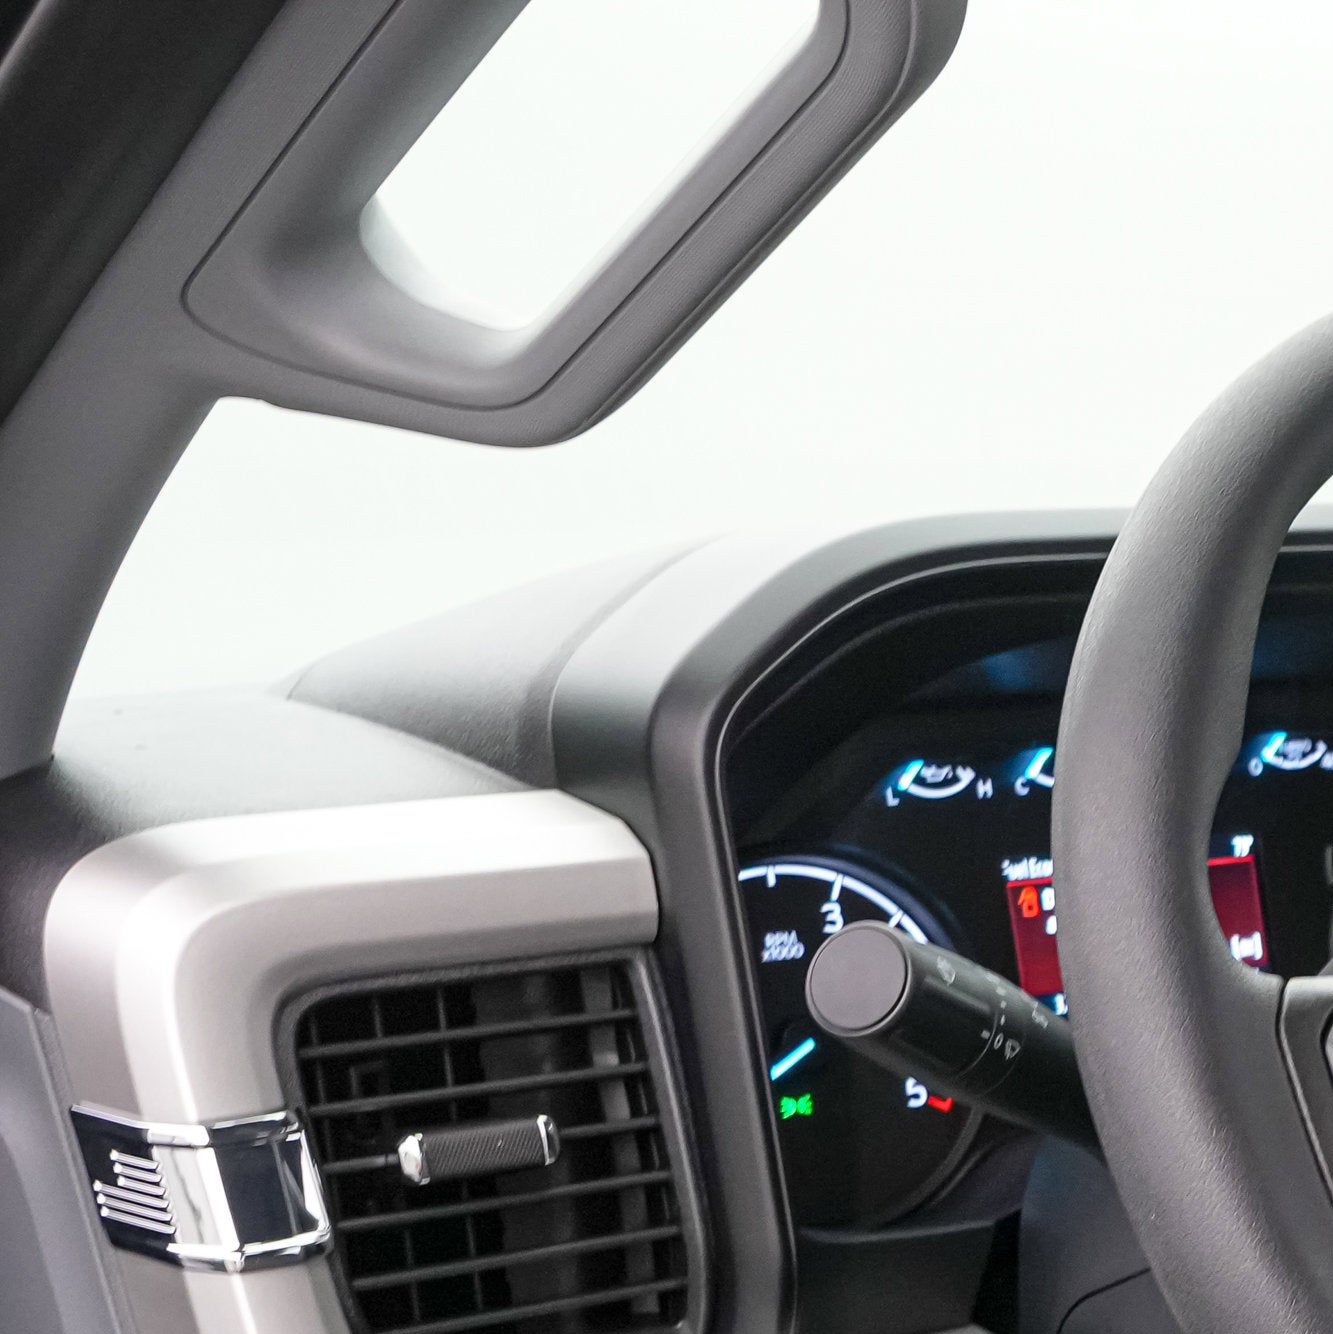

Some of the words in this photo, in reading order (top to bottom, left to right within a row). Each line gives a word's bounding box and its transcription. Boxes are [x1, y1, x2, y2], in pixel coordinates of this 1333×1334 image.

[886, 786, 900, 807] L
[976, 777, 994, 800] H
[820, 902, 844, 934] 3
[905, 1076, 928, 1108] 5
